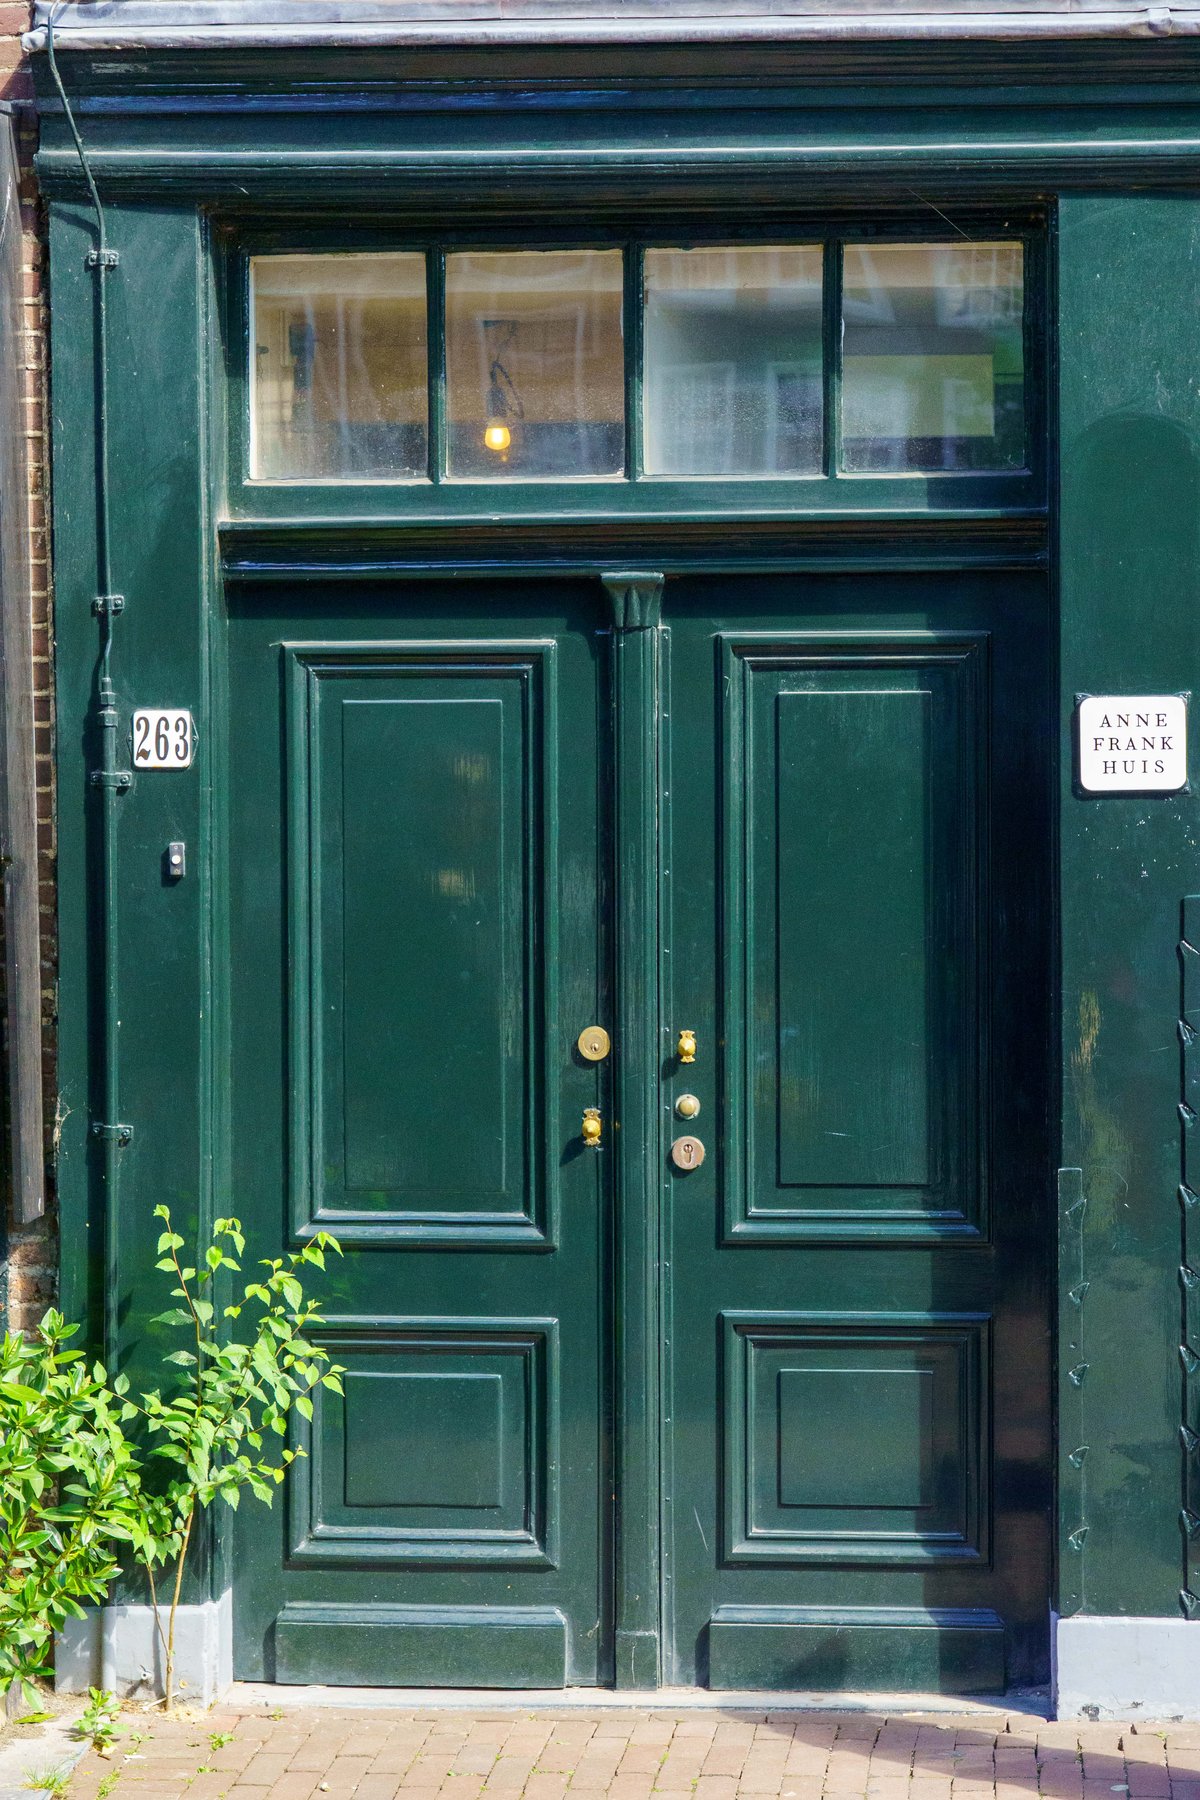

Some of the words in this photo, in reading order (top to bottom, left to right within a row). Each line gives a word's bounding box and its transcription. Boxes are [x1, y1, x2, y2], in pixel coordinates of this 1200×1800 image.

[1099, 713, 1168, 728] ANNE
[135, 716, 190, 761] 263
[1093, 736, 1174, 751] FRANK
[1102, 760, 1165, 774] HUIS
